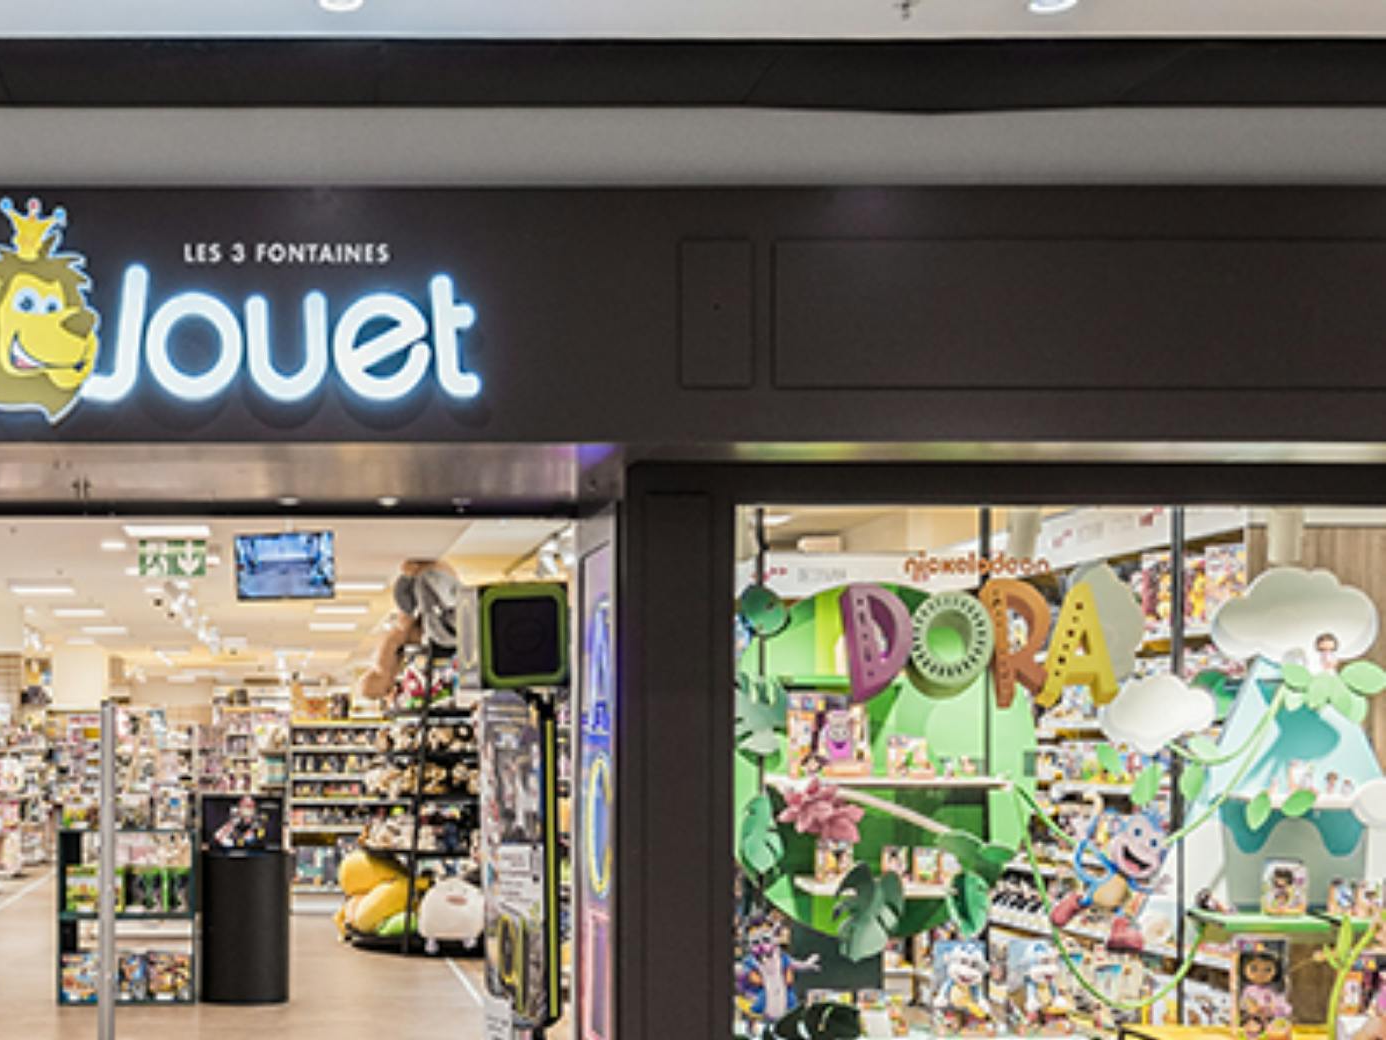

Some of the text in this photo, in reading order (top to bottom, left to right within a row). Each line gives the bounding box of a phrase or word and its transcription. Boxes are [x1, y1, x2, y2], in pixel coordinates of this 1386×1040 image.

[183, 243, 391, 263] LES 3 FONTAINES
[88, 263, 481, 400] Jouet
[840, 577, 1118, 709] DORA
